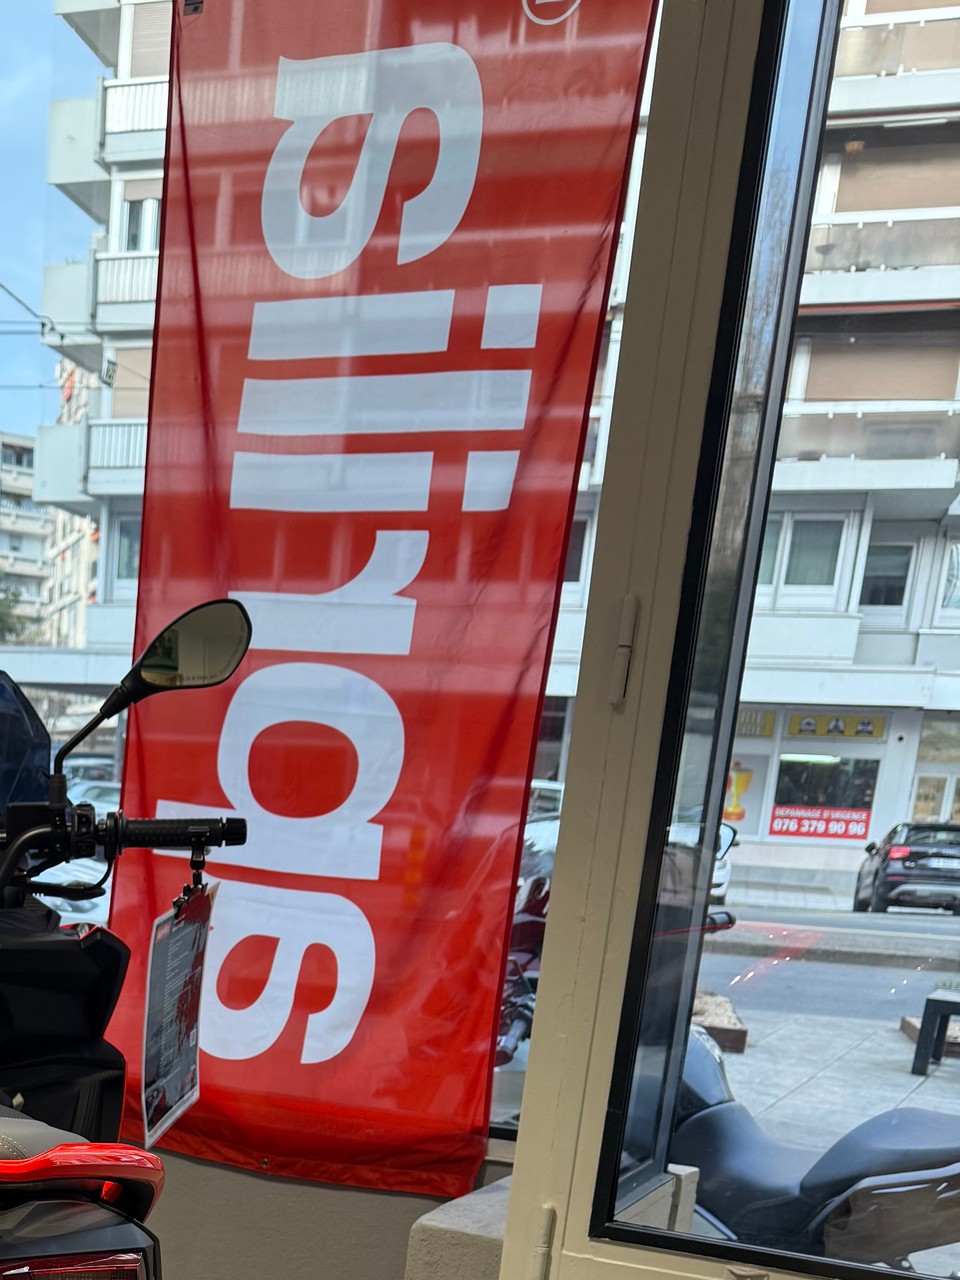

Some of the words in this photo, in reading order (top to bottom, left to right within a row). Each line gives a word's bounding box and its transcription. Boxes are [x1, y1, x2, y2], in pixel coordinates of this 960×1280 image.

[772, 818, 798, 832] 076
[800, 819, 826, 834] 379
[828, 821, 846, 835] 90
